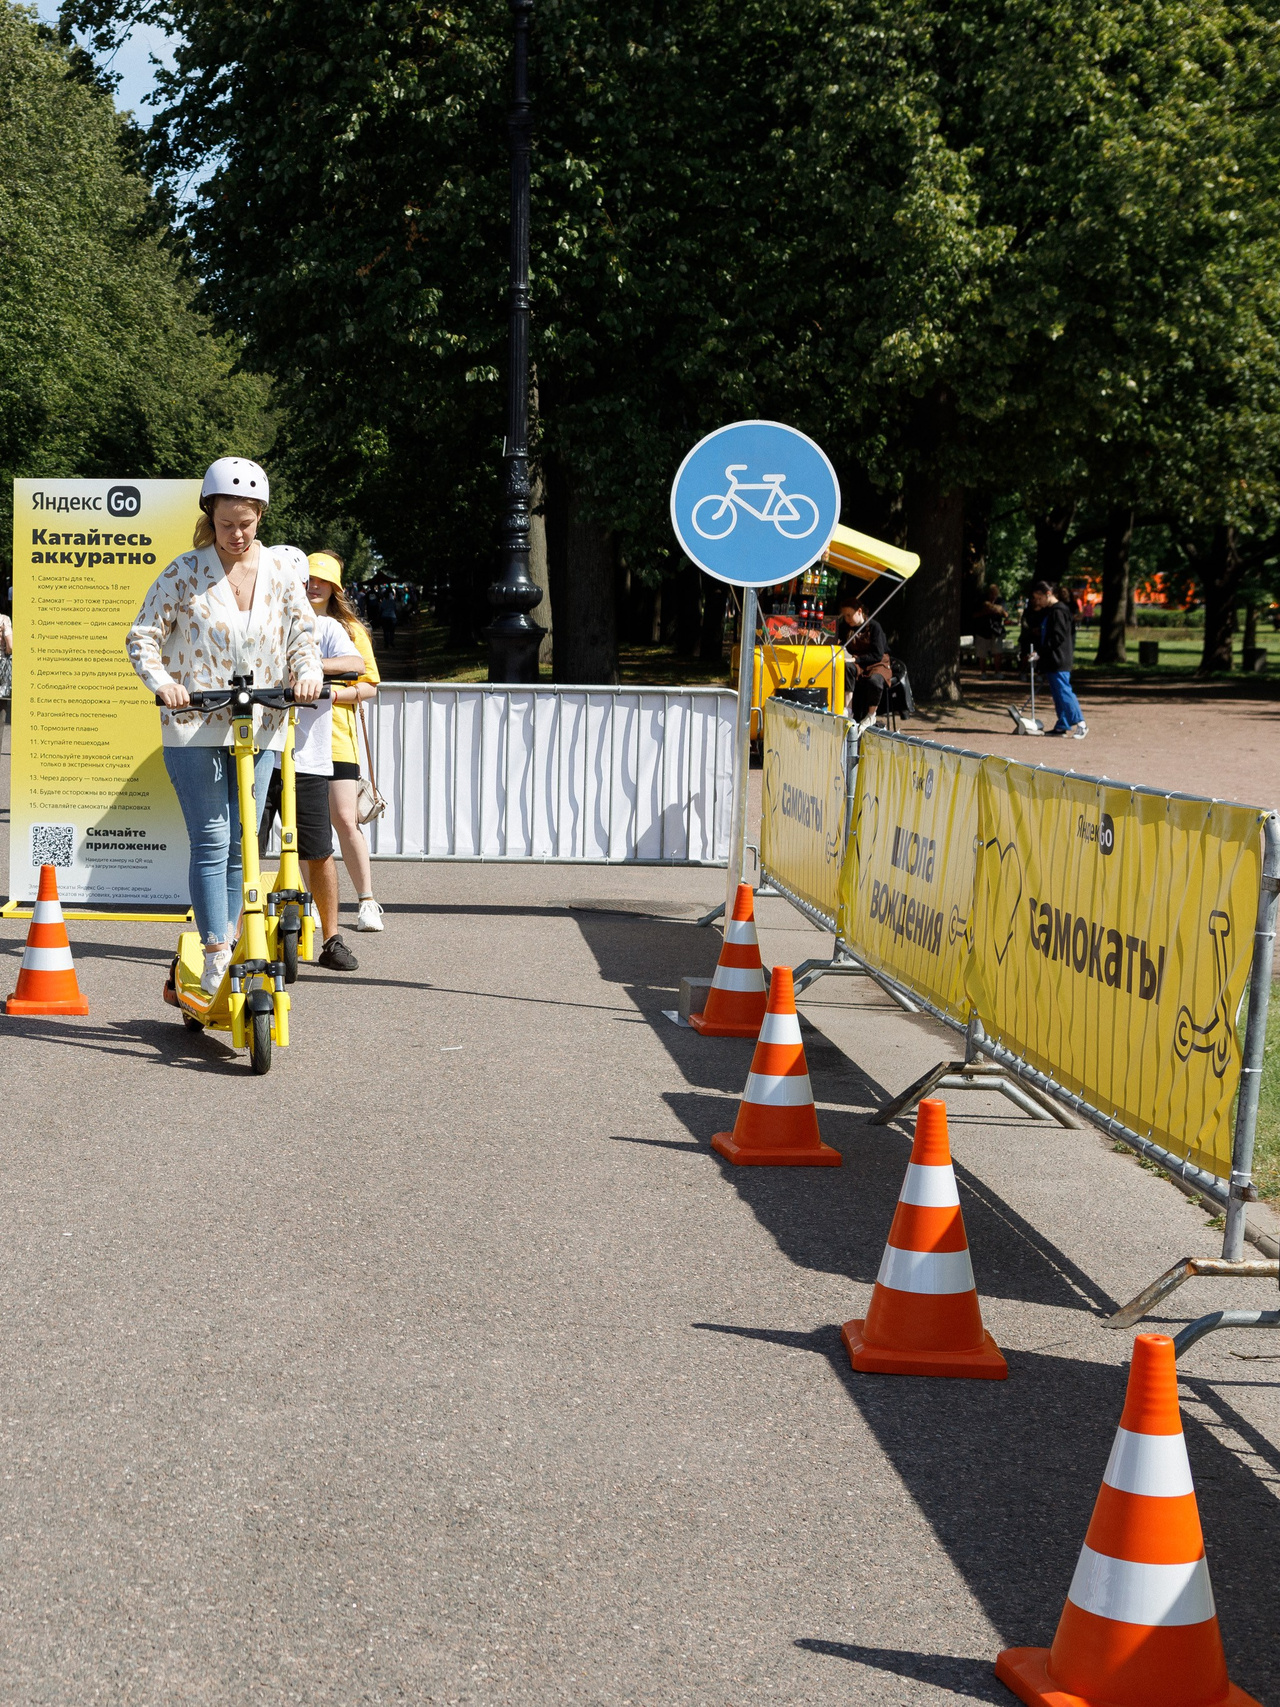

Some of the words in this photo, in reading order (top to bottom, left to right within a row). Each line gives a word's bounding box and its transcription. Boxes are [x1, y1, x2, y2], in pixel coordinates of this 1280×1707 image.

[32, 492, 102, 513] Яндекс
[110, 491, 138, 512] Go
[32, 528, 152, 546] Катайтесь
[31, 551, 156, 568] аккуратно
[37, 633, 58, 641] Лучше
[782, 782, 823, 834] самокаты
[86, 827, 146, 838] Скачайте
[1100, 821, 1113, 847] Go
[86, 842, 167, 851] приложение
[891, 826, 936, 884] школа
[870, 880, 944, 957] вождения
[1028, 897, 1165, 1005] самокаты
